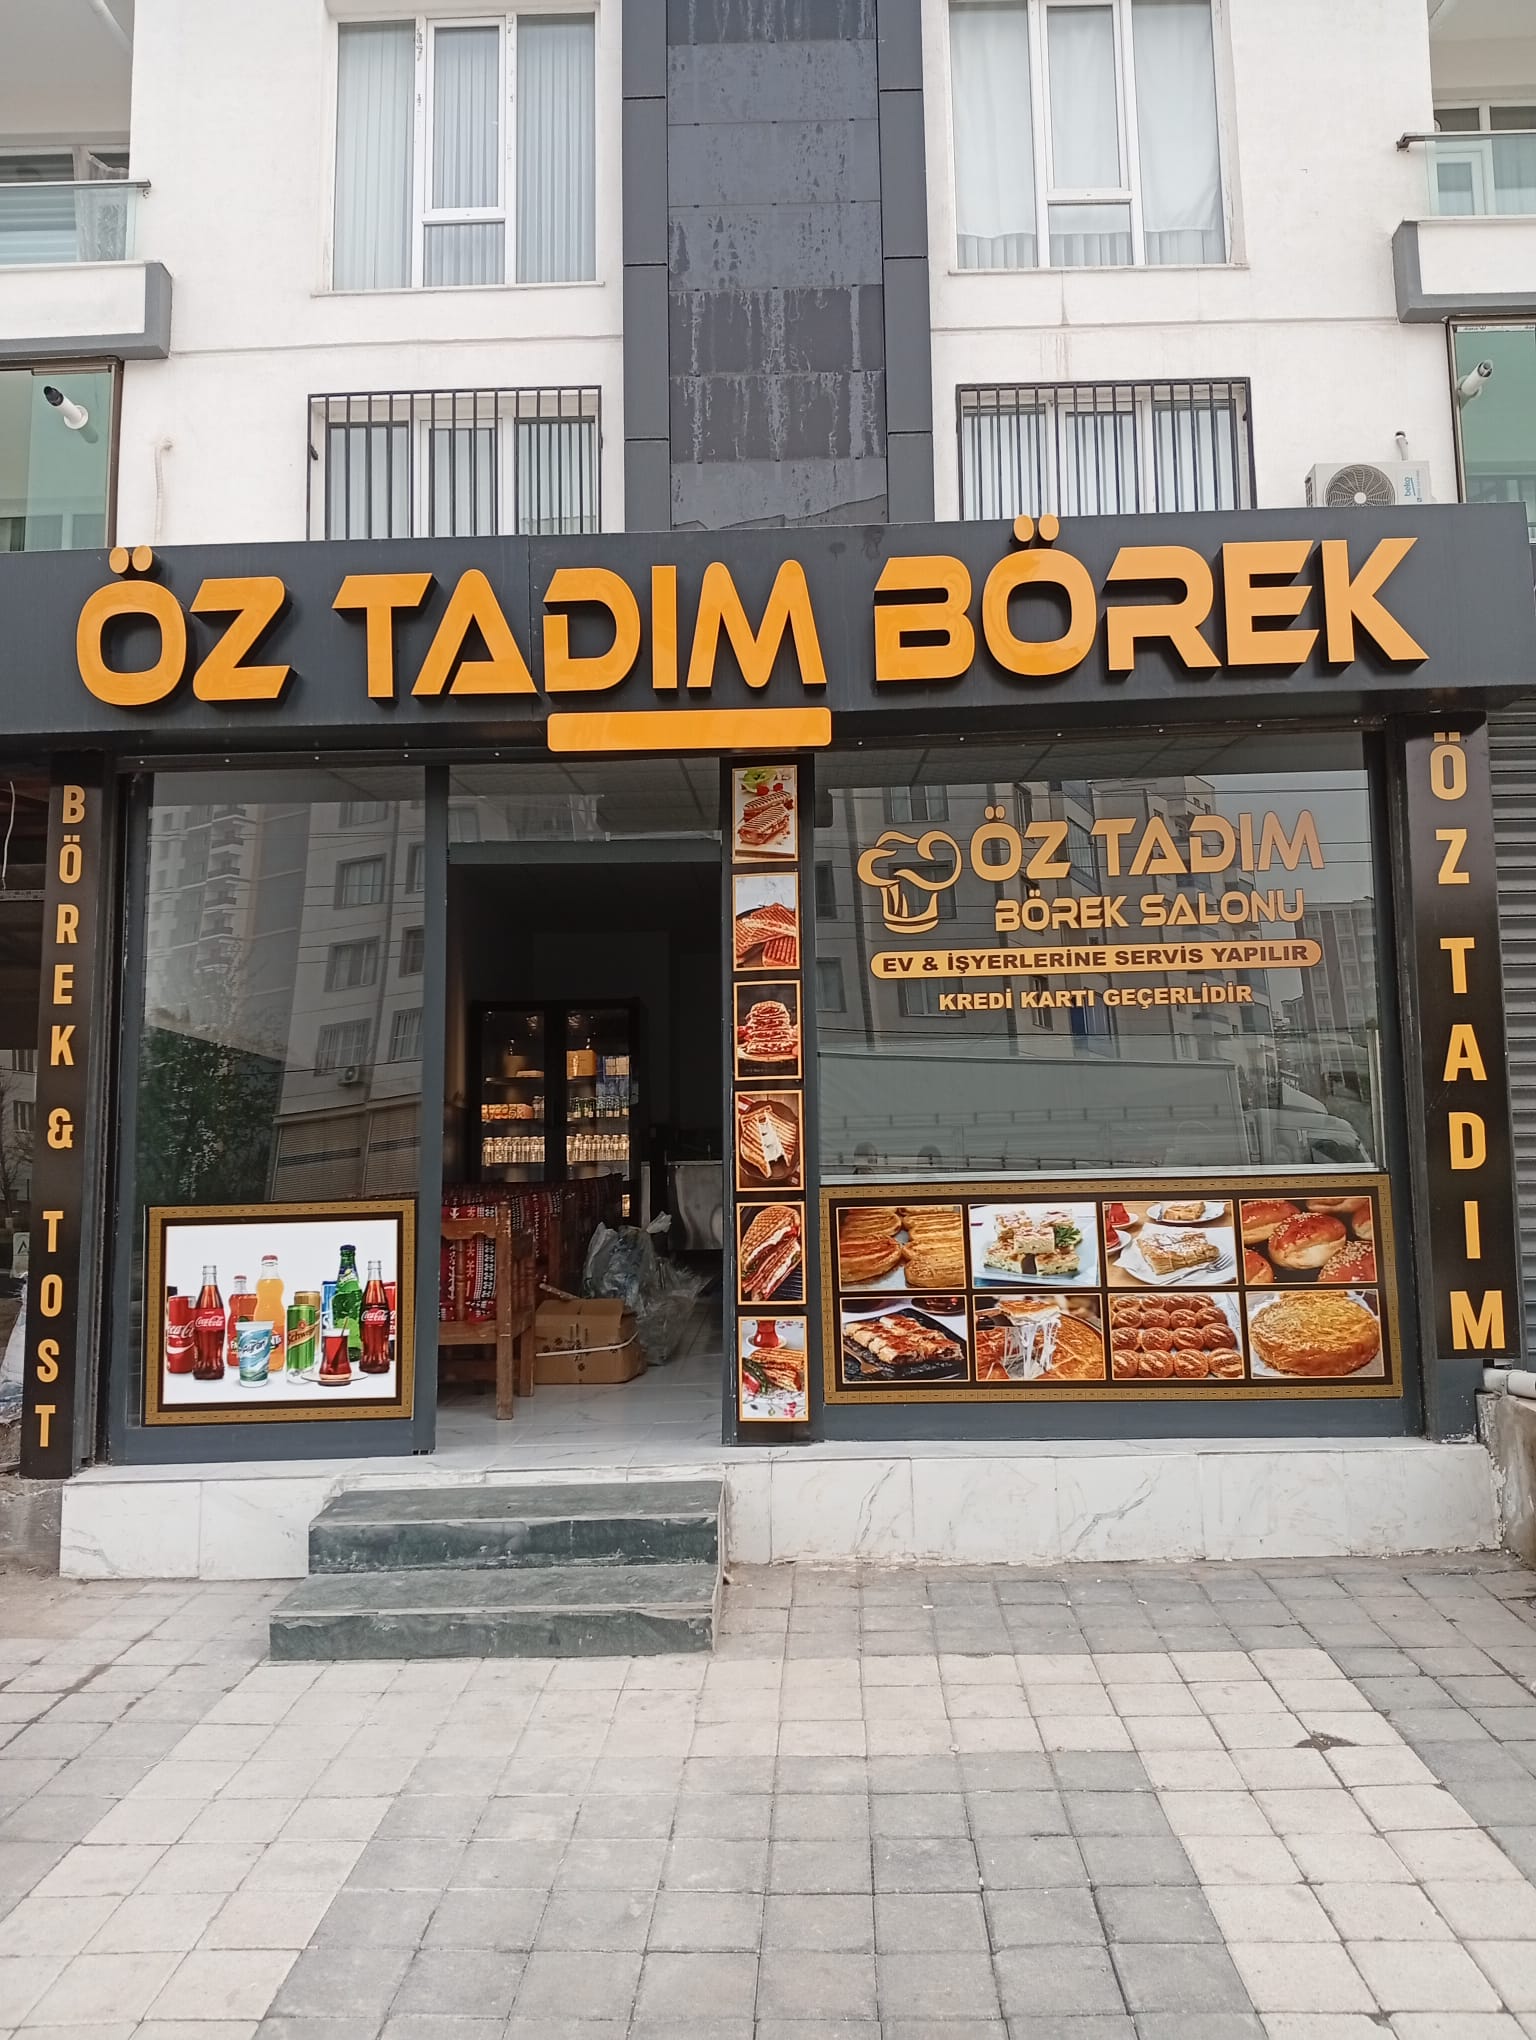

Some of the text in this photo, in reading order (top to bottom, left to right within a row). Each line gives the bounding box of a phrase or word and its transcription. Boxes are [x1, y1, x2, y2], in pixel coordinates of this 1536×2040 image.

[76, 513, 1430, 706] ÖZ TADIM BÖREK
[970, 805, 1324, 882] ÖZ TADIM
[995, 888, 1304, 932] BÖREK SALONU
[883, 945, 1308, 974] EV & İŞYERLERİNE SERVİS YAPILIR
[939, 981, 1253, 1012] KREDİ KARTI GEÇERLİDİR
[1430, 731, 1506, 1350] ÖZ TADIM
[34, 785, 86, 1448] BÖREK & TOST
